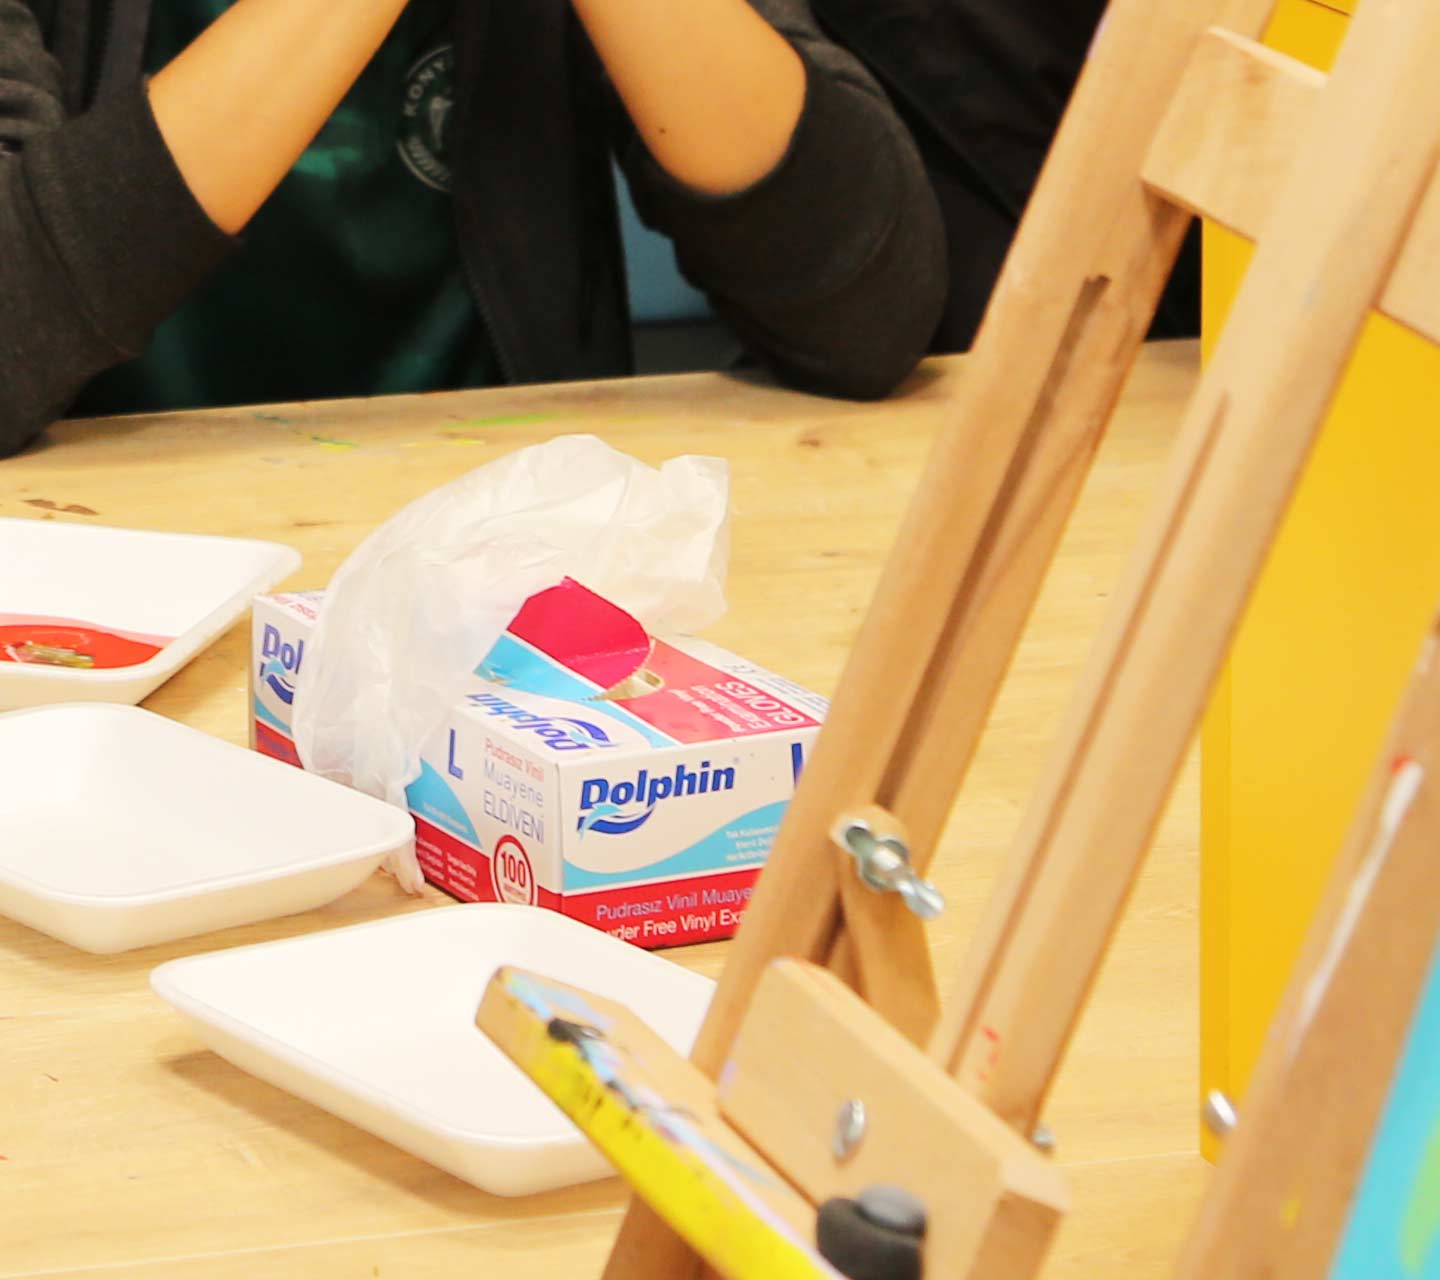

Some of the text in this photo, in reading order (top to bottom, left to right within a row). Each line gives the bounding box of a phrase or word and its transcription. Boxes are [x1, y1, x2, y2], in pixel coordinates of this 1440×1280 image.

[403, 58, 446, 117] KONY
[261, 623, 305, 675] Dol
[714, 681, 806, 725] GLOVES
[448, 728, 464, 781] L
[580, 761, 735, 810] Dolphin
[502, 851, 526, 887] 100
[702, 887, 752, 905] Muaye
[643, 920, 677, 936] Free
[680, 911, 716, 932] Vinyl
